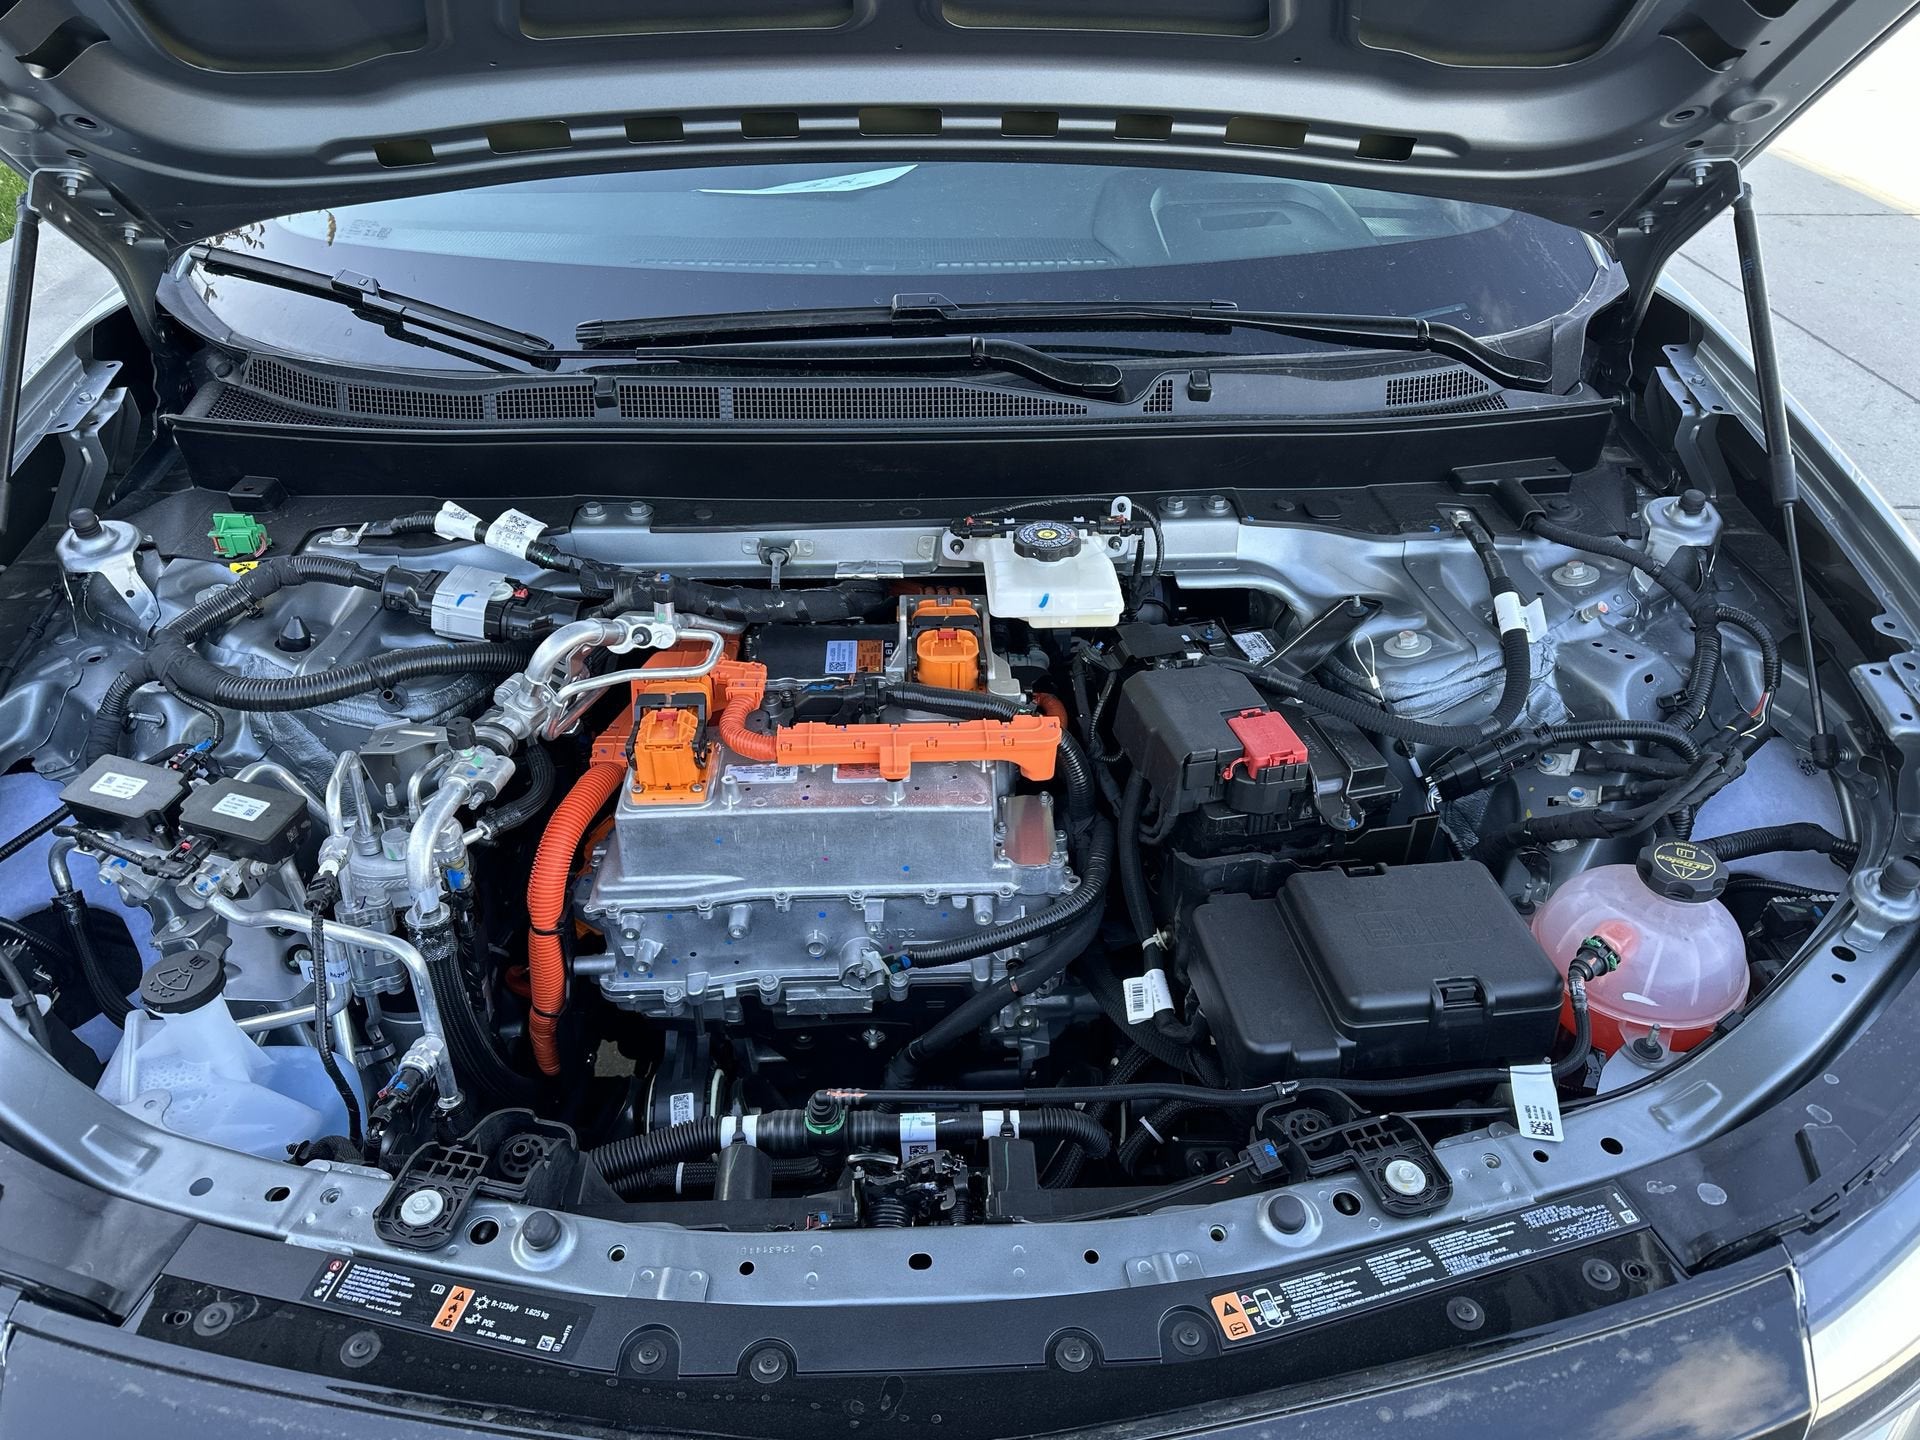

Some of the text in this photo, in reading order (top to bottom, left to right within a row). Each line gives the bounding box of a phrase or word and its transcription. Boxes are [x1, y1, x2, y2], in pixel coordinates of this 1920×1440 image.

[1657, 854, 1713, 871] ACDelco
[491, 1300, 520, 1313] R-1234yf
[541, 1311, 550, 1320] kg
[481, 1319, 496, 1328] POE
